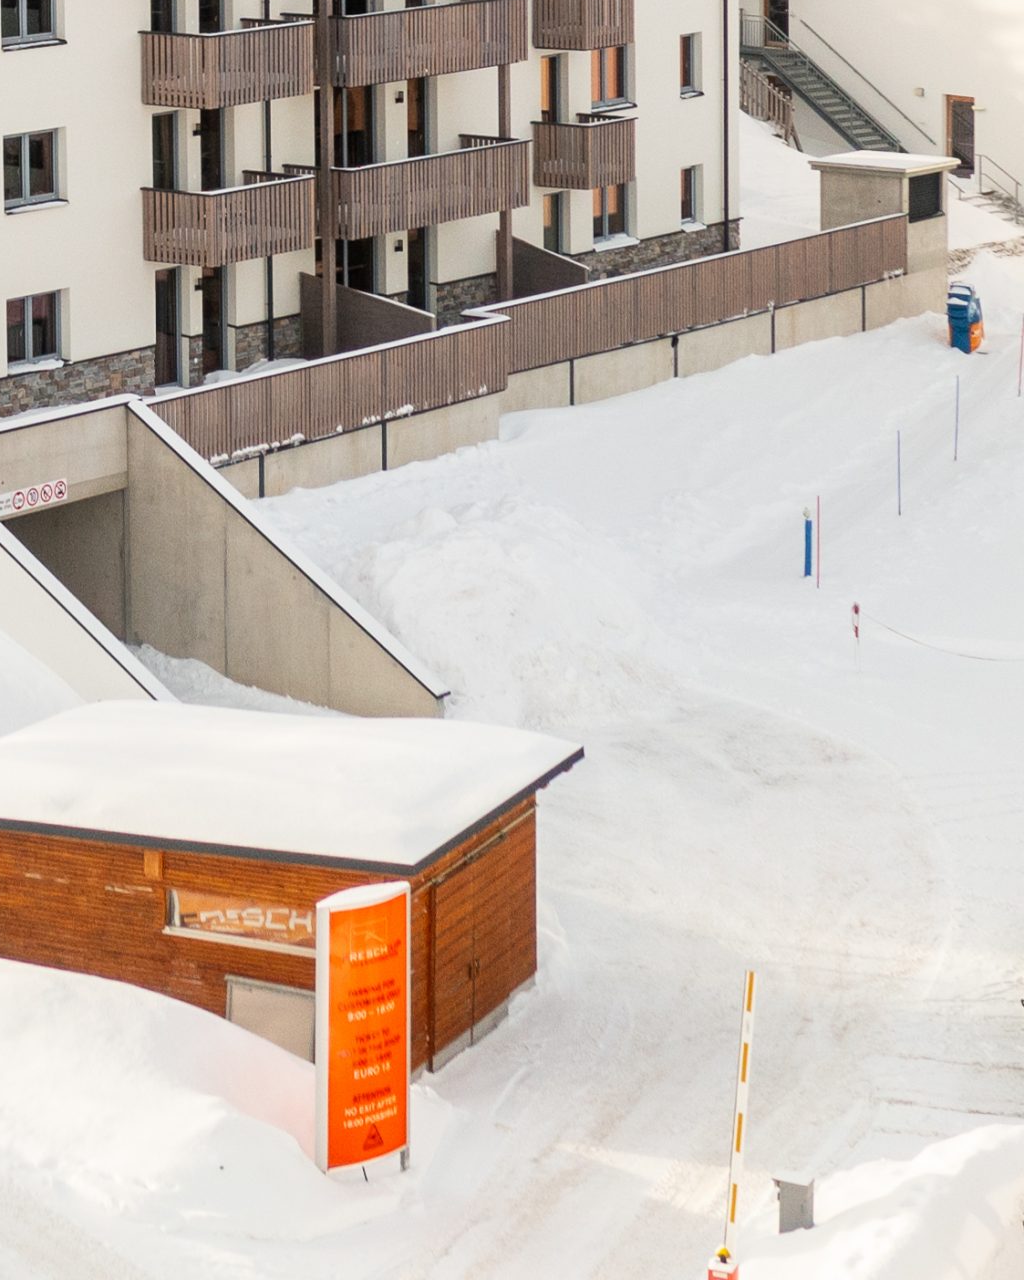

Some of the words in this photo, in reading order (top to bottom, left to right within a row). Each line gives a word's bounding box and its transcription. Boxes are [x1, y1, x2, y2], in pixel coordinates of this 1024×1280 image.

[354, 1063, 380, 1080] EURO
[344, 1105, 357, 1118] NO
[359, 1101, 375, 1115] EXIT
[377, 1093, 397, 1110] AFTER
[365, 1104, 398, 1125] POSSIBLE
